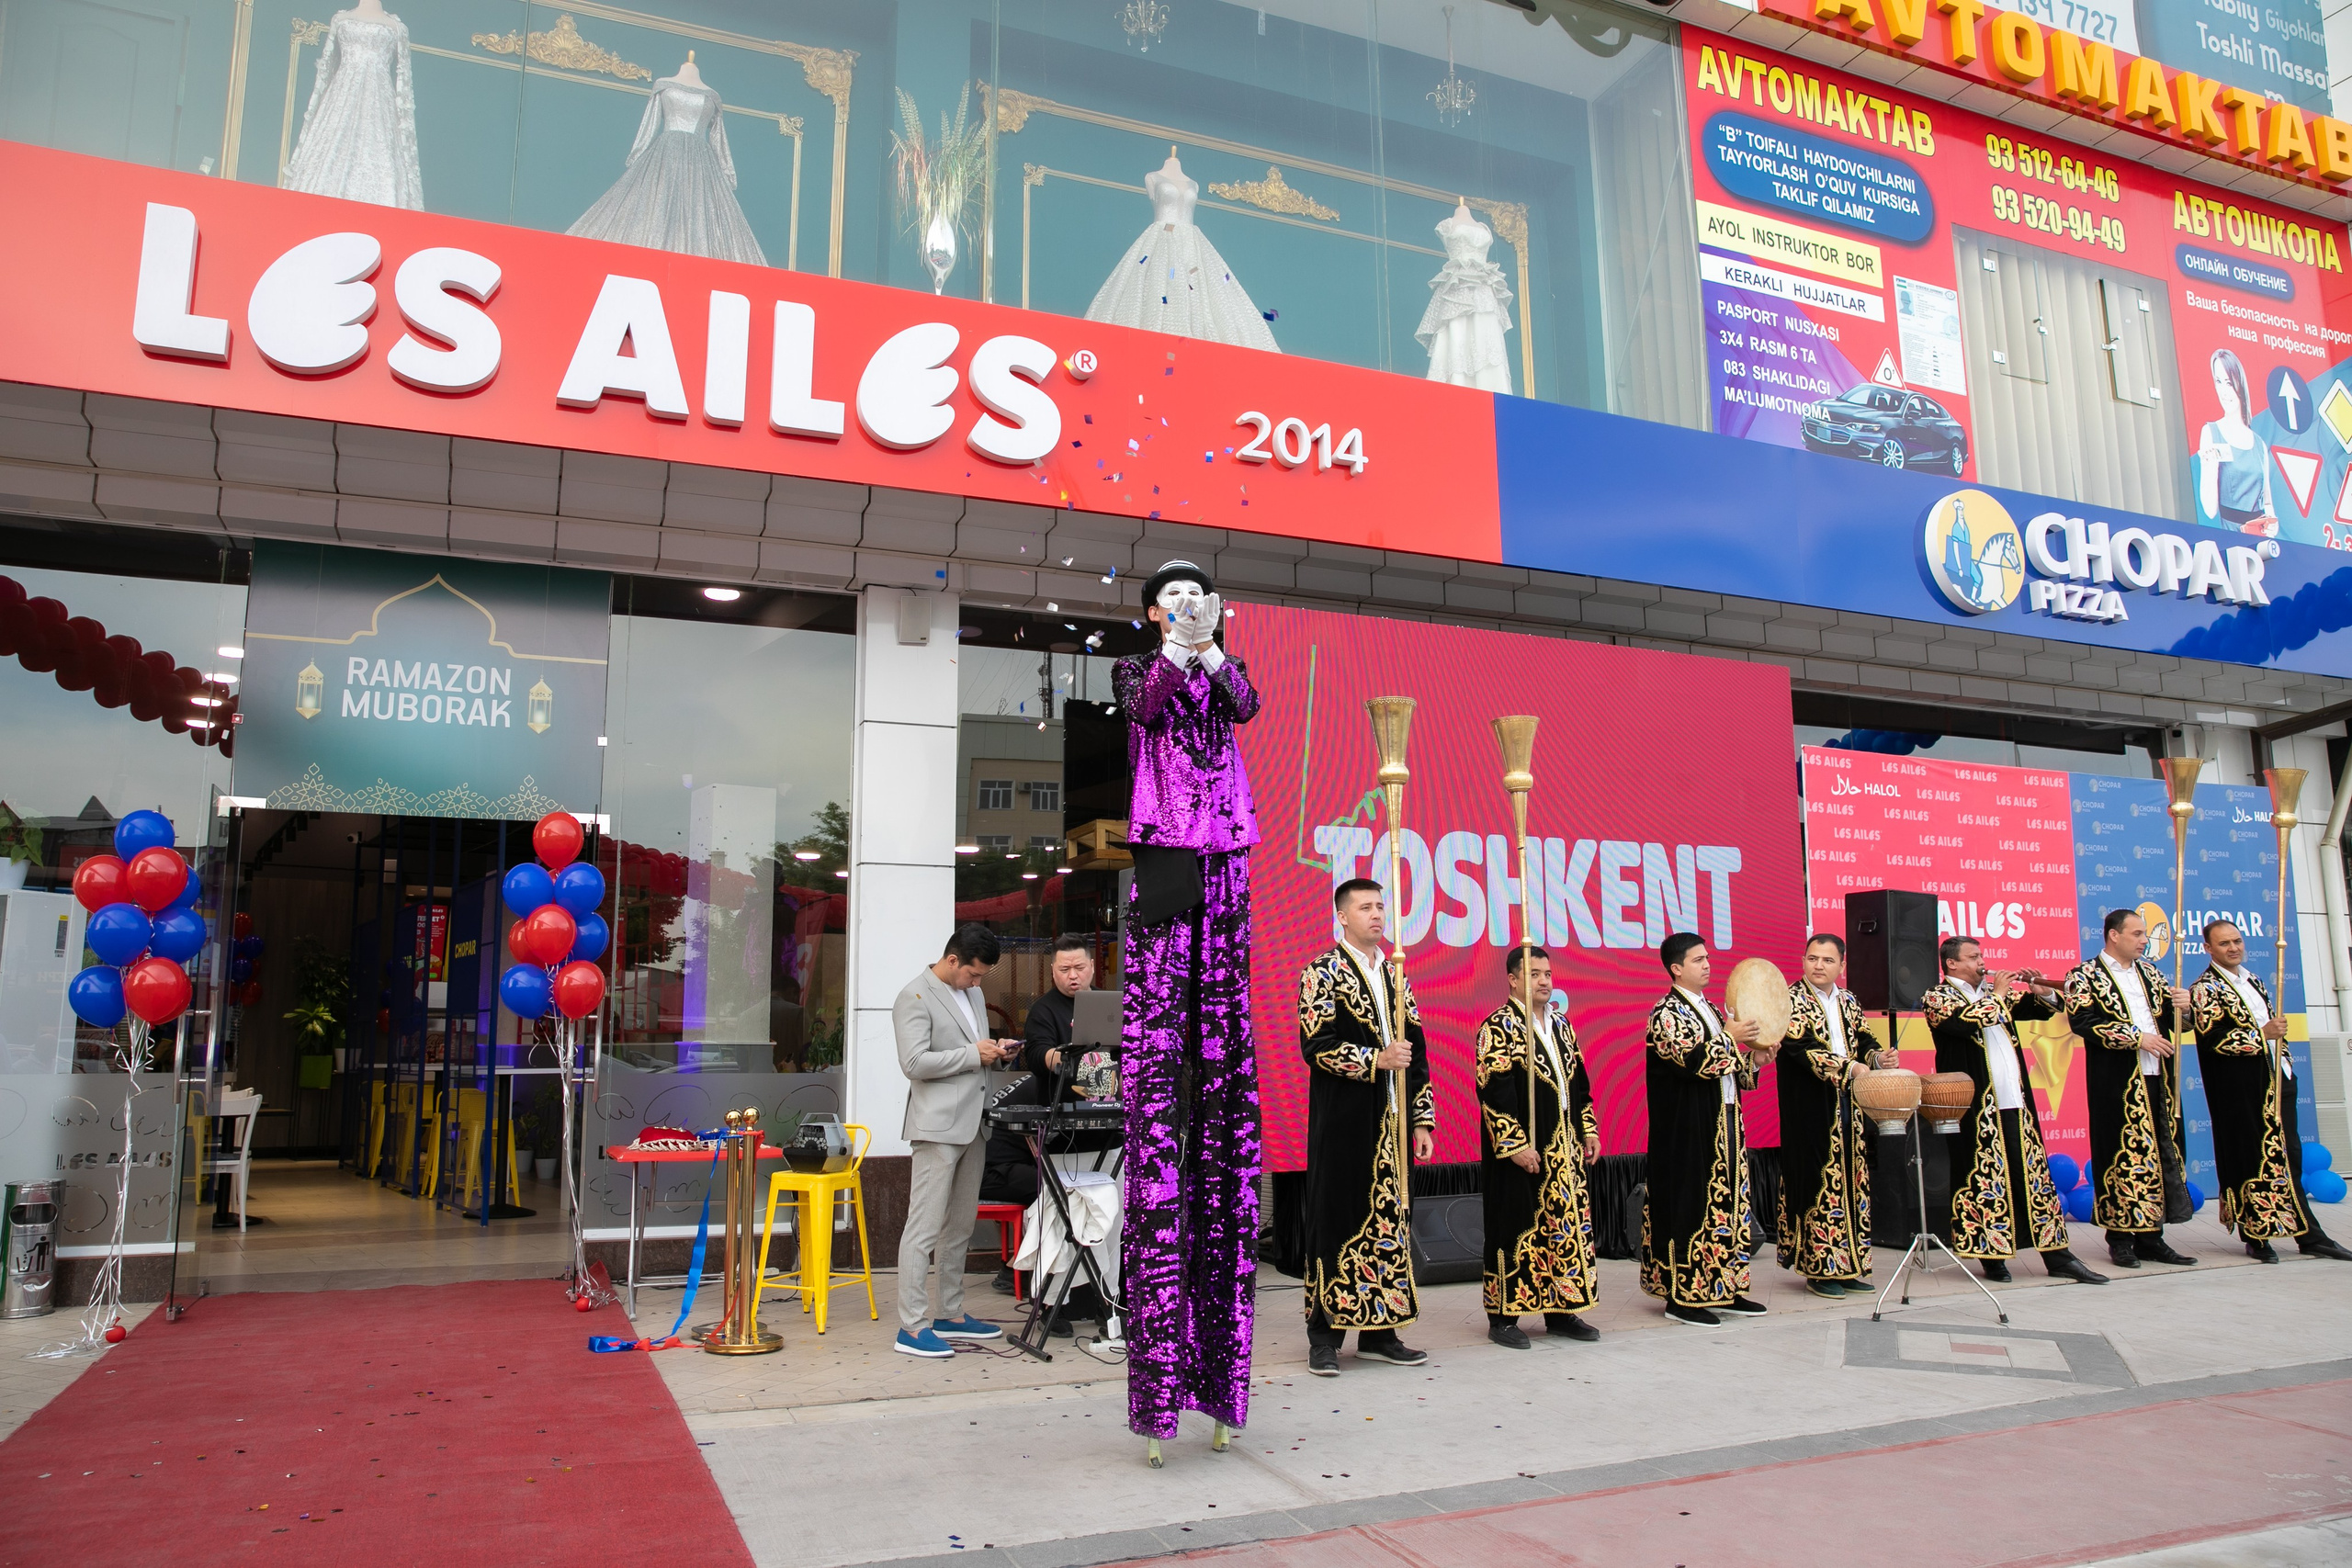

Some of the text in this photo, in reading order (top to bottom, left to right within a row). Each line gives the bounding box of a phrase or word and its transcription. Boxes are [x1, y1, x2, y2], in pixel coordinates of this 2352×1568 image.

[2062, 0, 2118, 43] 7727
[2204, 0, 2260, 32] abiiy
[2196, 21, 2254, 66] Toshli
[1697, 44, 1936, 157] AVTOMAKTAB
[1717, 145, 1808, 184] TAYYORLASH
[1862, 186, 1920, 216] KURSIGA
[1746, 131, 1797, 160] TOIFALI
[1804, 148, 1916, 194] HAYDOVCHILARNI
[1985, 133, 2120, 204] 93 512-64-46
[1772, 181, 1875, 223] TAKLIF QILAMIZ
[1991, 185, 2126, 254] 93 520-94-49
[1708, 216, 1874, 274] AYOL INSTRUKTOR BOR
[2173, 189, 2344, 275] АВТОШКОЛА
[1724, 266, 1783, 292] KERAKLI
[1793, 283, 1866, 313] HUJJATLAR
[2185, 254, 2288, 292] ОНЛАЙН ОБУЧЕНИЕ
[1717, 299, 1840, 342] PASPORT NUSXASI
[2186, 290, 2352, 345] Ваша безопасность на дорог
[1750, 336, 1787, 358] RASM
[1791, 345, 1798, 360] 6
[1800, 348, 1817, 365] TA
[2228, 325, 2326, 358] наша профессия
[1723, 359, 1831, 395] 083 SHAKLIDAGI
[1236, 411, 1369, 477] 2014
[2025, 512, 2271, 607] CHOPAR
[2030, 580, 2130, 622] PIZZA
[346, 656, 512, 696] RAMAZON
[341, 689, 512, 728] MUBORAK
[1864, 783, 1901, 797] HALOL
[1313, 825, 1742, 951] TOSHKENT
[455, 940, 476, 959] CHOPAR
[992, 1074, 1033, 1107] REEBO
